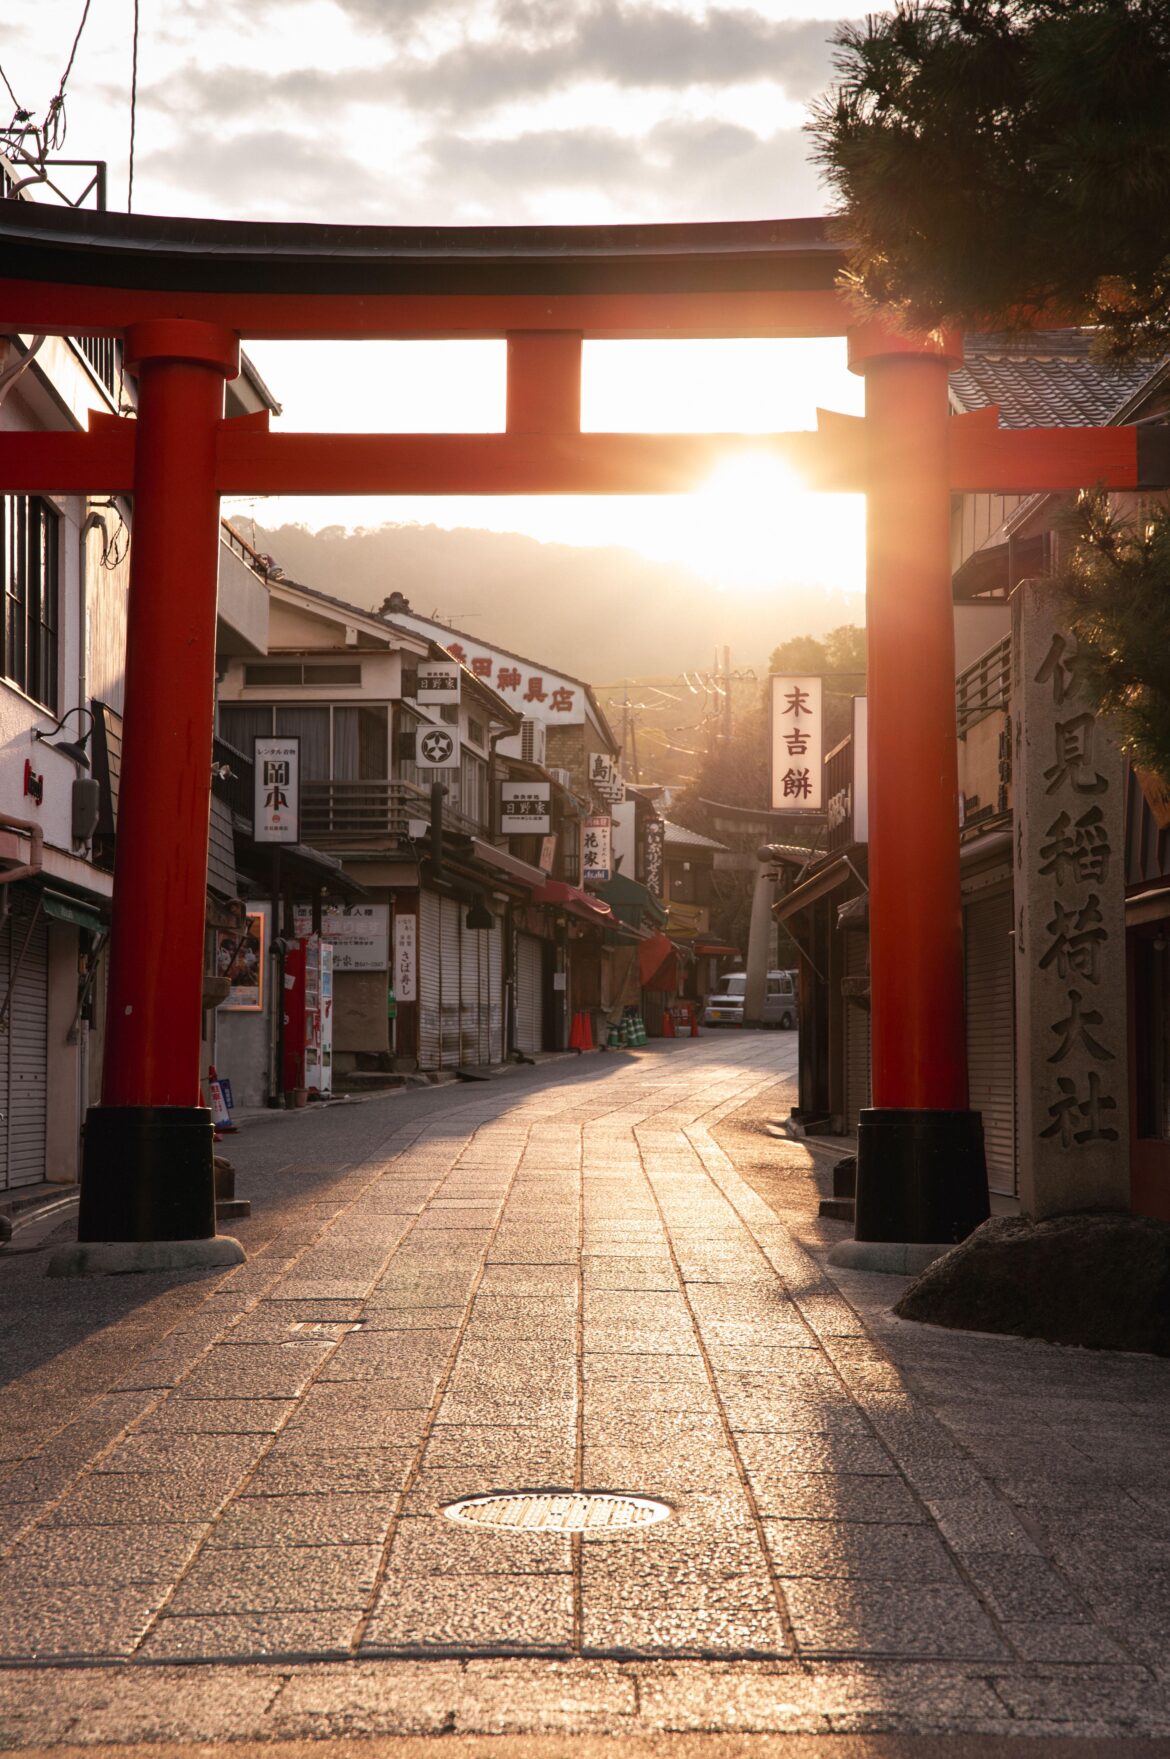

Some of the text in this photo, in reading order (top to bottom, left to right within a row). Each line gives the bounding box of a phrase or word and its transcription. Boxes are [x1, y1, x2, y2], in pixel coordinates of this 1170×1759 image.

[781, 686, 813, 800] 末吉餅
[263, 760, 290, 811] 岡本
[584, 832, 599, 867] 花家
